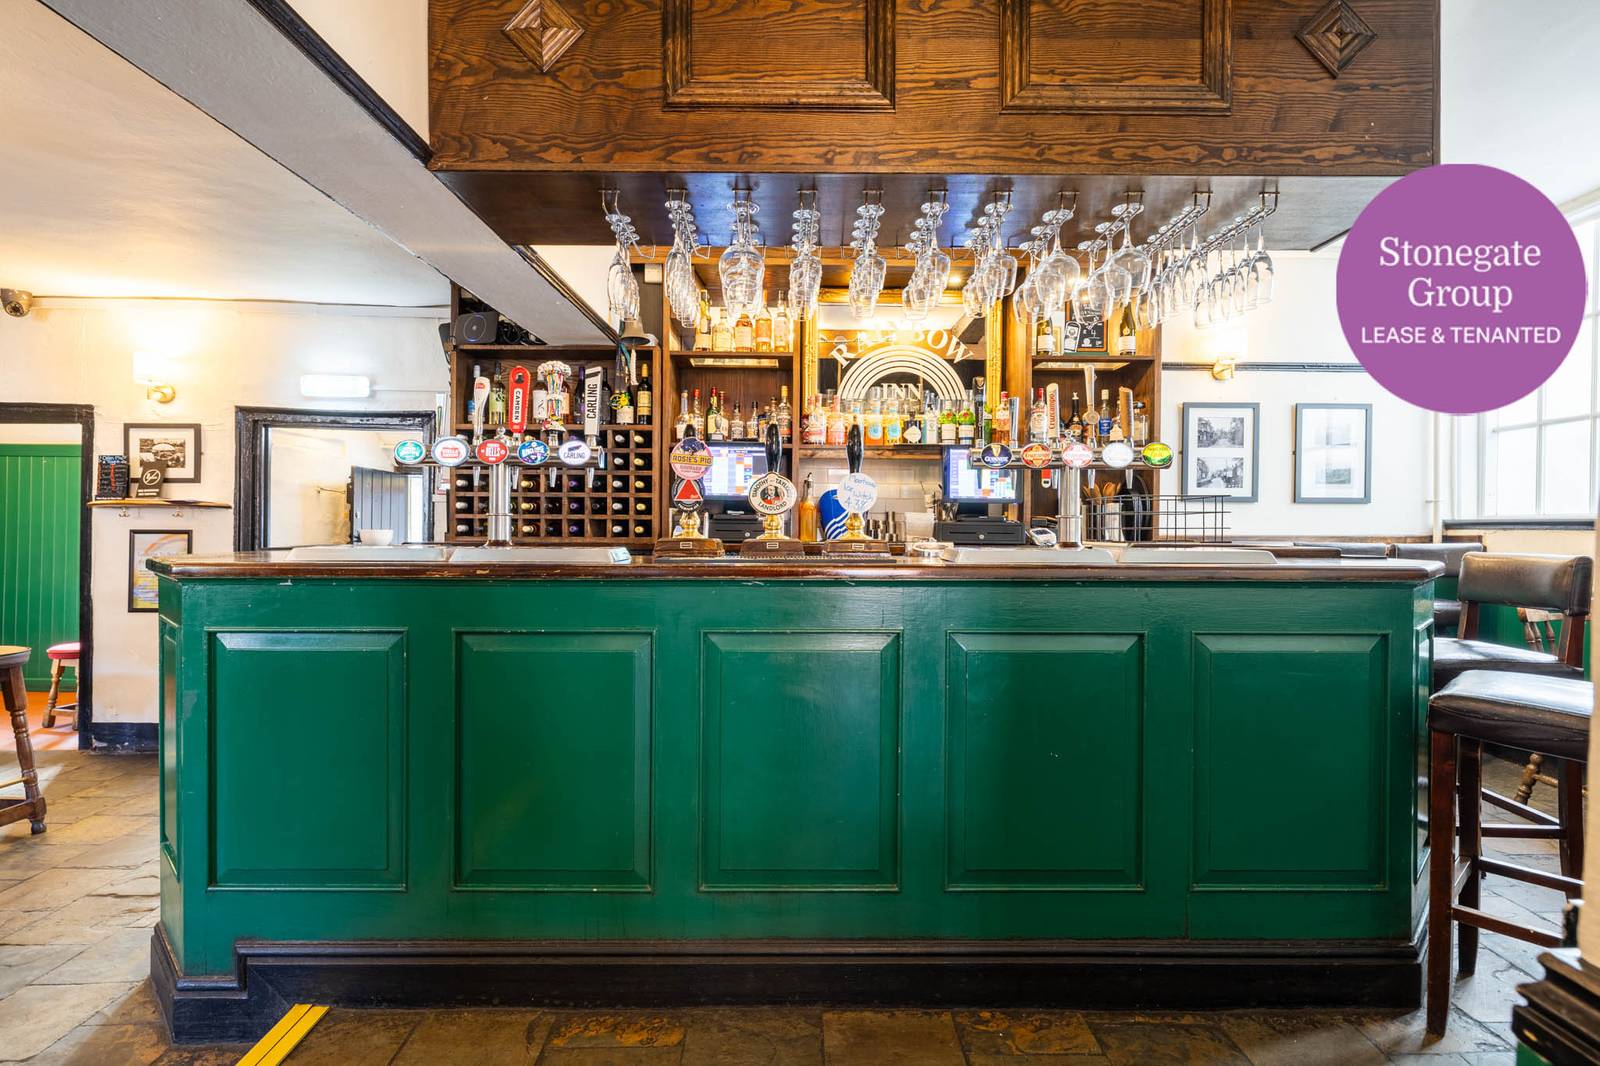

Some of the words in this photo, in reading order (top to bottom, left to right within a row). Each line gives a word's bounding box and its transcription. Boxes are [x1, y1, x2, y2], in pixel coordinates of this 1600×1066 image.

[880, 382, 923, 400] INN
[586, 383, 598, 420] CARLING
[563, 452, 586, 460] CARLING
[672, 455, 698, 464] ROSIE'S
[751, 478, 769, 498] TIMOTHY
[757, 501, 788, 512] LANDLORD
